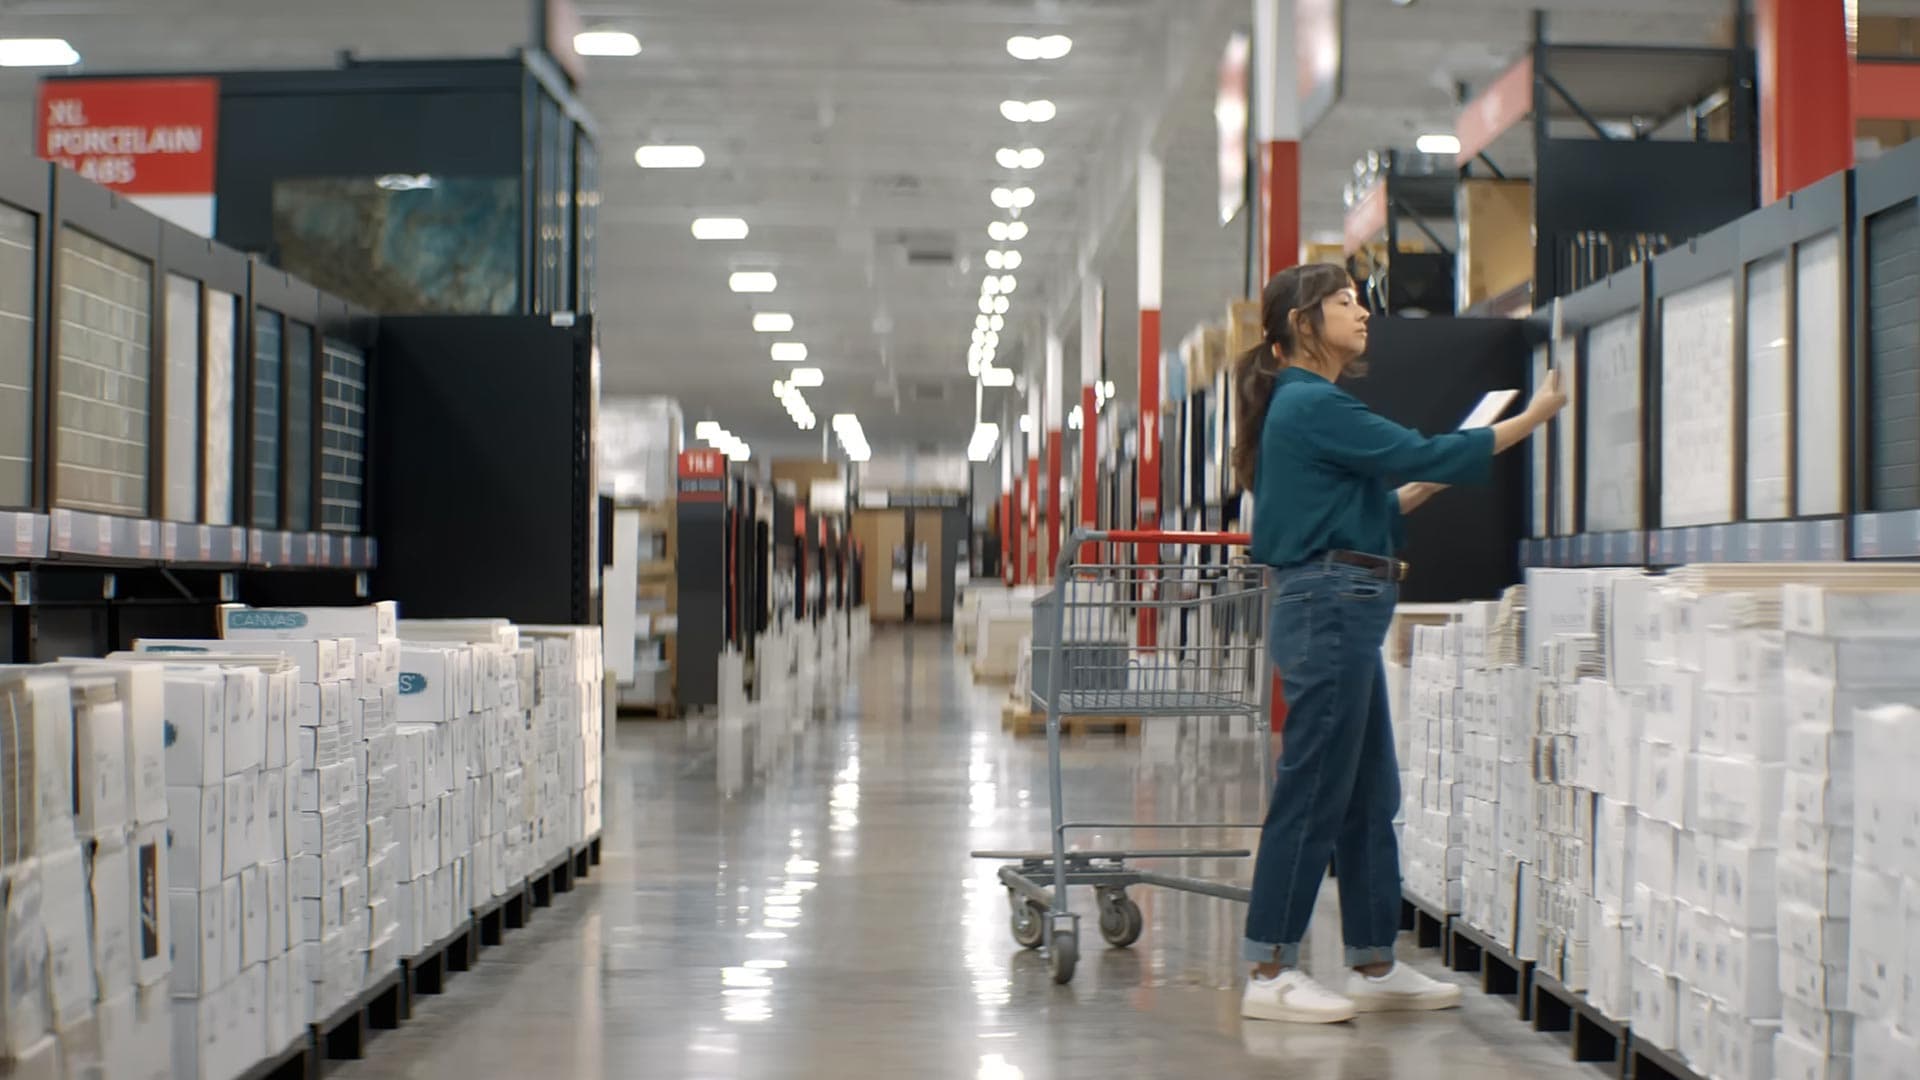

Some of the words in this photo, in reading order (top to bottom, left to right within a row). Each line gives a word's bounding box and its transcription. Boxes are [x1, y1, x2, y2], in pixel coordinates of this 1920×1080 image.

[48, 98, 87, 126] XL
[48, 125, 202, 155] PORCELAIN
[231, 613, 297, 626] CANVAS
